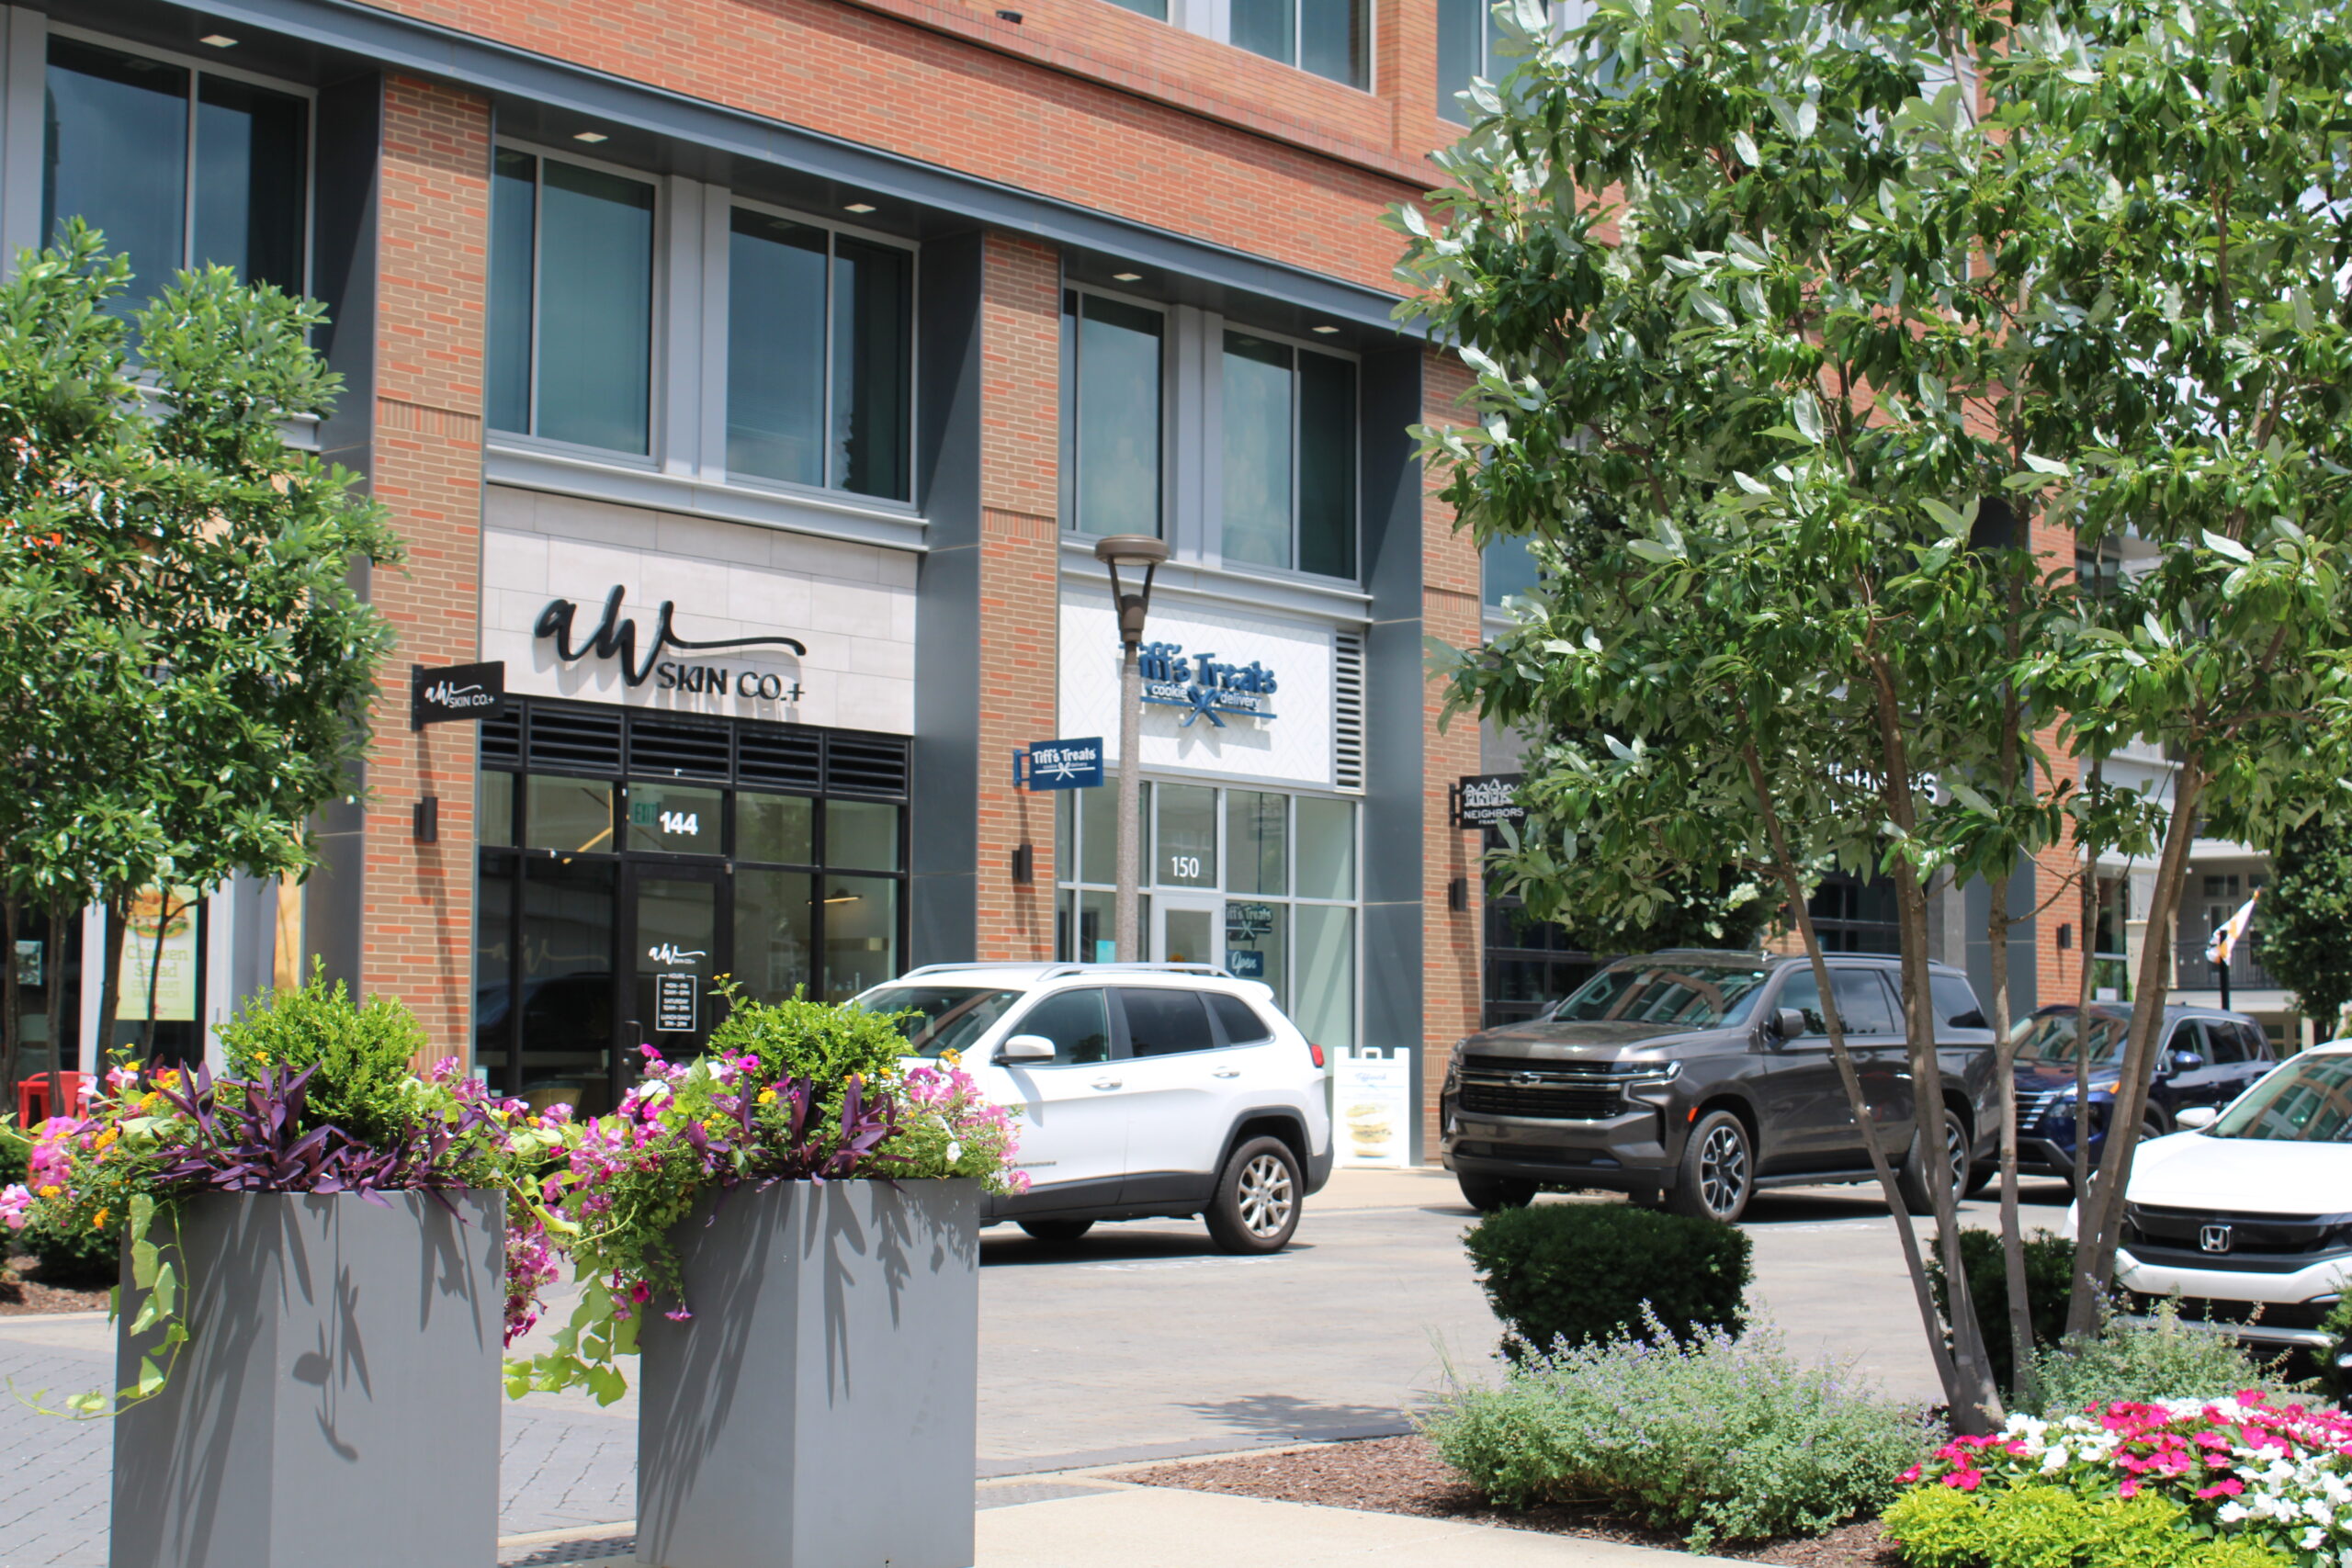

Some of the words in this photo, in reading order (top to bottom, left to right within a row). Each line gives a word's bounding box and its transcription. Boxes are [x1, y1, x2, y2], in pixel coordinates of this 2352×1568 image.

[656, 661, 728, 695] SKIN
[1118, 641, 1192, 682] iff's
[1193, 653, 1278, 694] Treats
[448, 696, 471, 709] SKIN
[1151, 684, 1189, 699] cookie
[1220, 692, 1261, 712] delivery
[1032, 749, 1061, 764] Tiff's
[1060, 747, 1097, 761] Treats
[660, 811, 698, 836] 144
[1464, 807, 1524, 819] NEIGHBORS
[1171, 856, 1200, 878] 150
[125, 943, 189, 961] Chiken
[1232, 951, 1258, 975] Open
[134, 962, 178, 978] Saad
